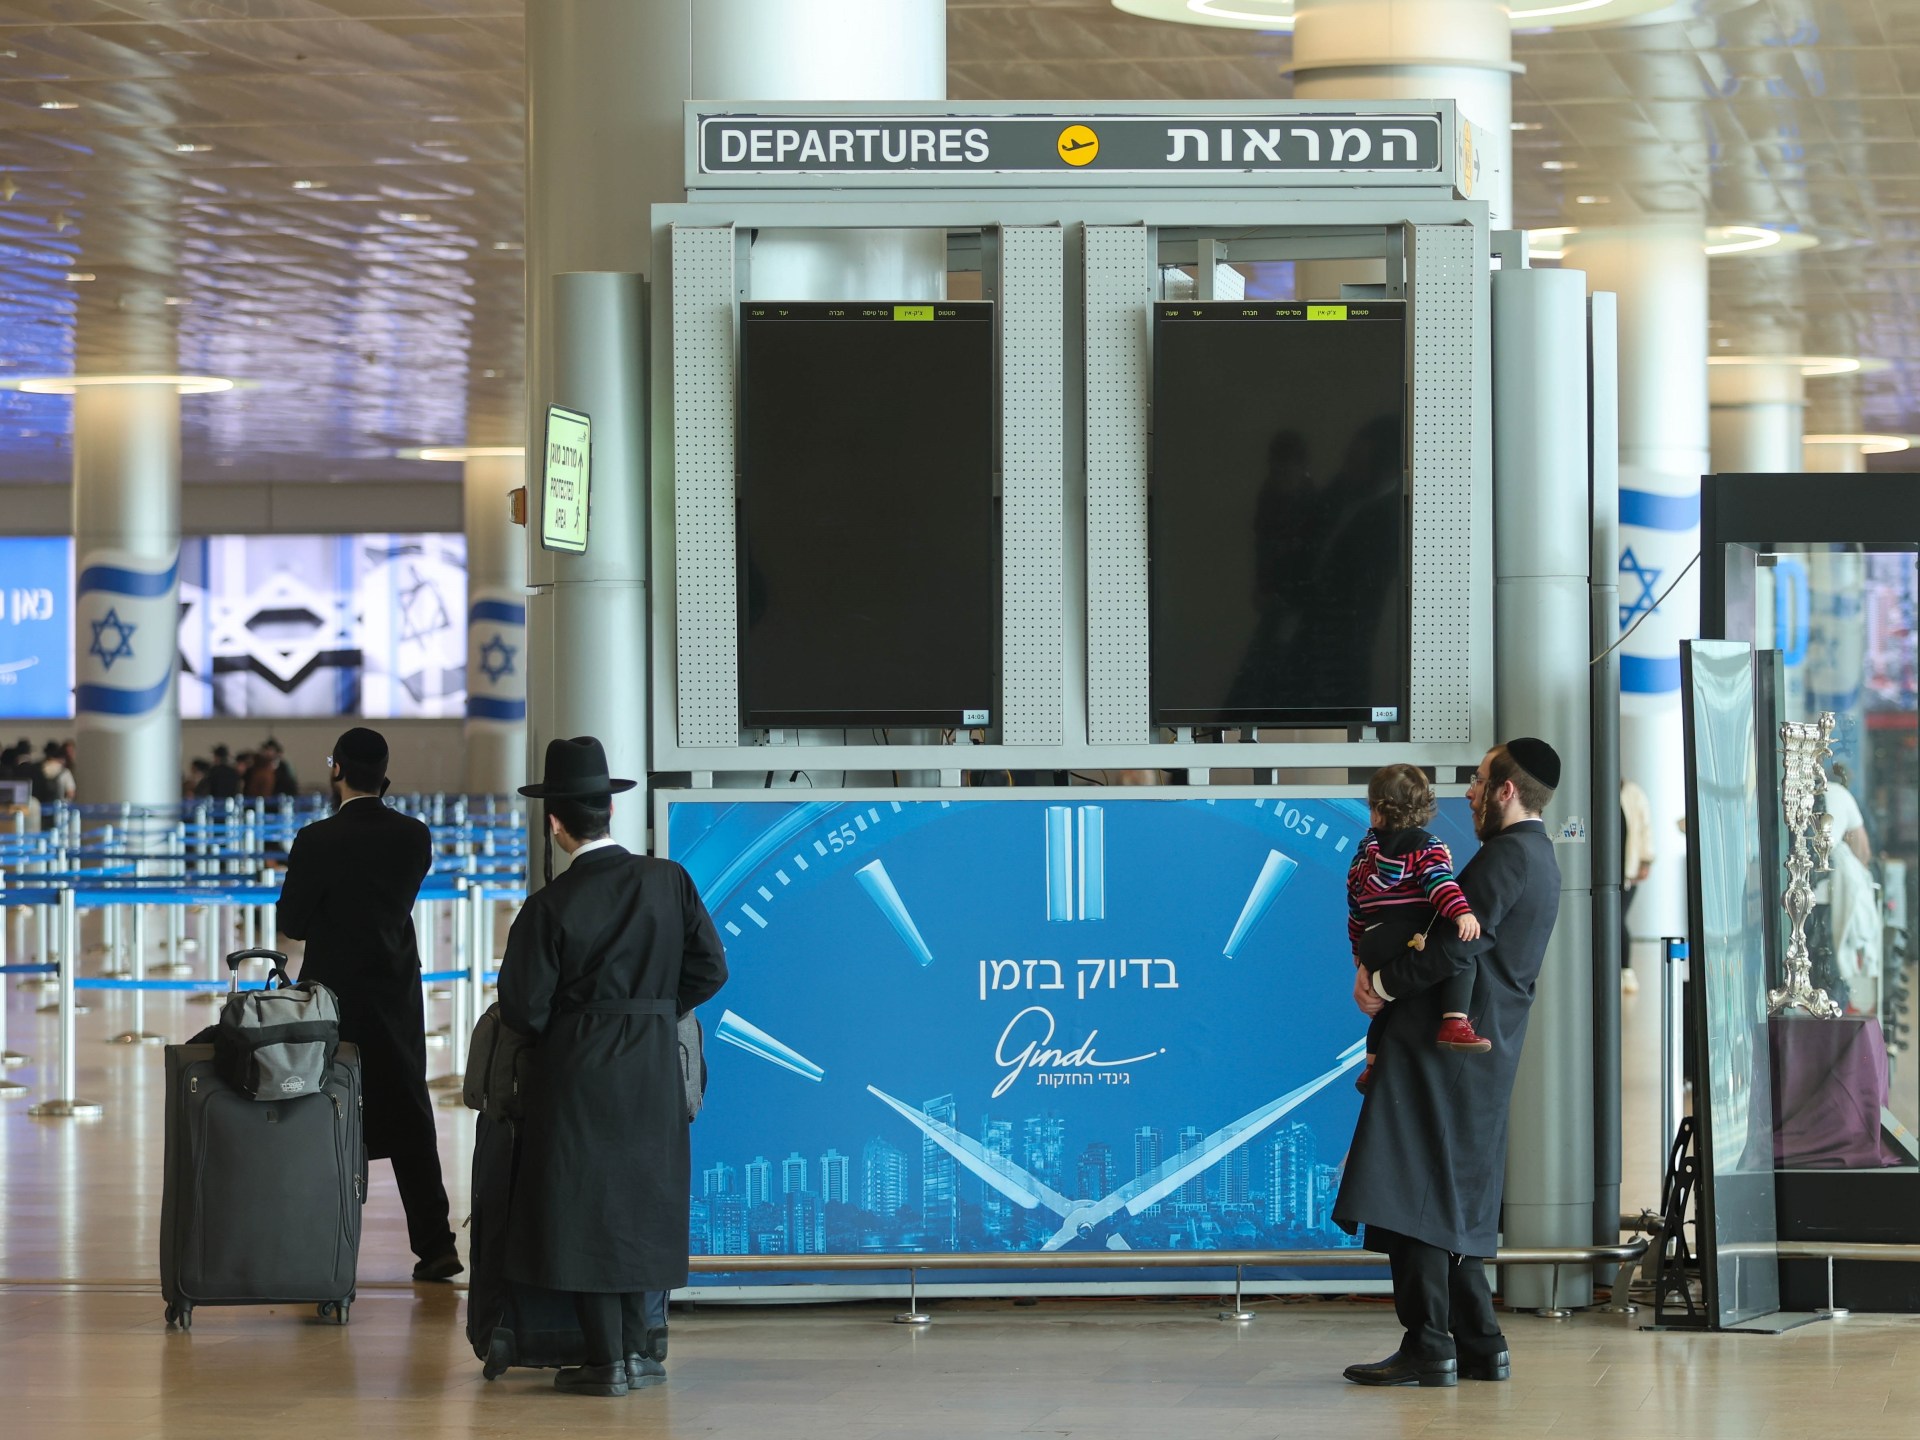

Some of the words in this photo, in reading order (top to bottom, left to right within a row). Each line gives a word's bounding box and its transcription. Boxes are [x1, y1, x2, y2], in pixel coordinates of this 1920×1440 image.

[719, 127, 990, 163] DEPARTURES
[1165, 126, 1419, 162] המראות
[550, 477, 575, 501] PROTECTED
[555, 508, 567, 528] AREA
[11, 588, 54, 625] כאן
[1283, 808, 1315, 835] 05
[827, 822, 857, 853] 55
[979, 959, 1065, 1001] בזמן
[1077, 958, 1179, 1000] בדיוק
[1036, 1073, 1093, 1089] החזקות
[1098, 1073, 1130, 1085] גינדי
